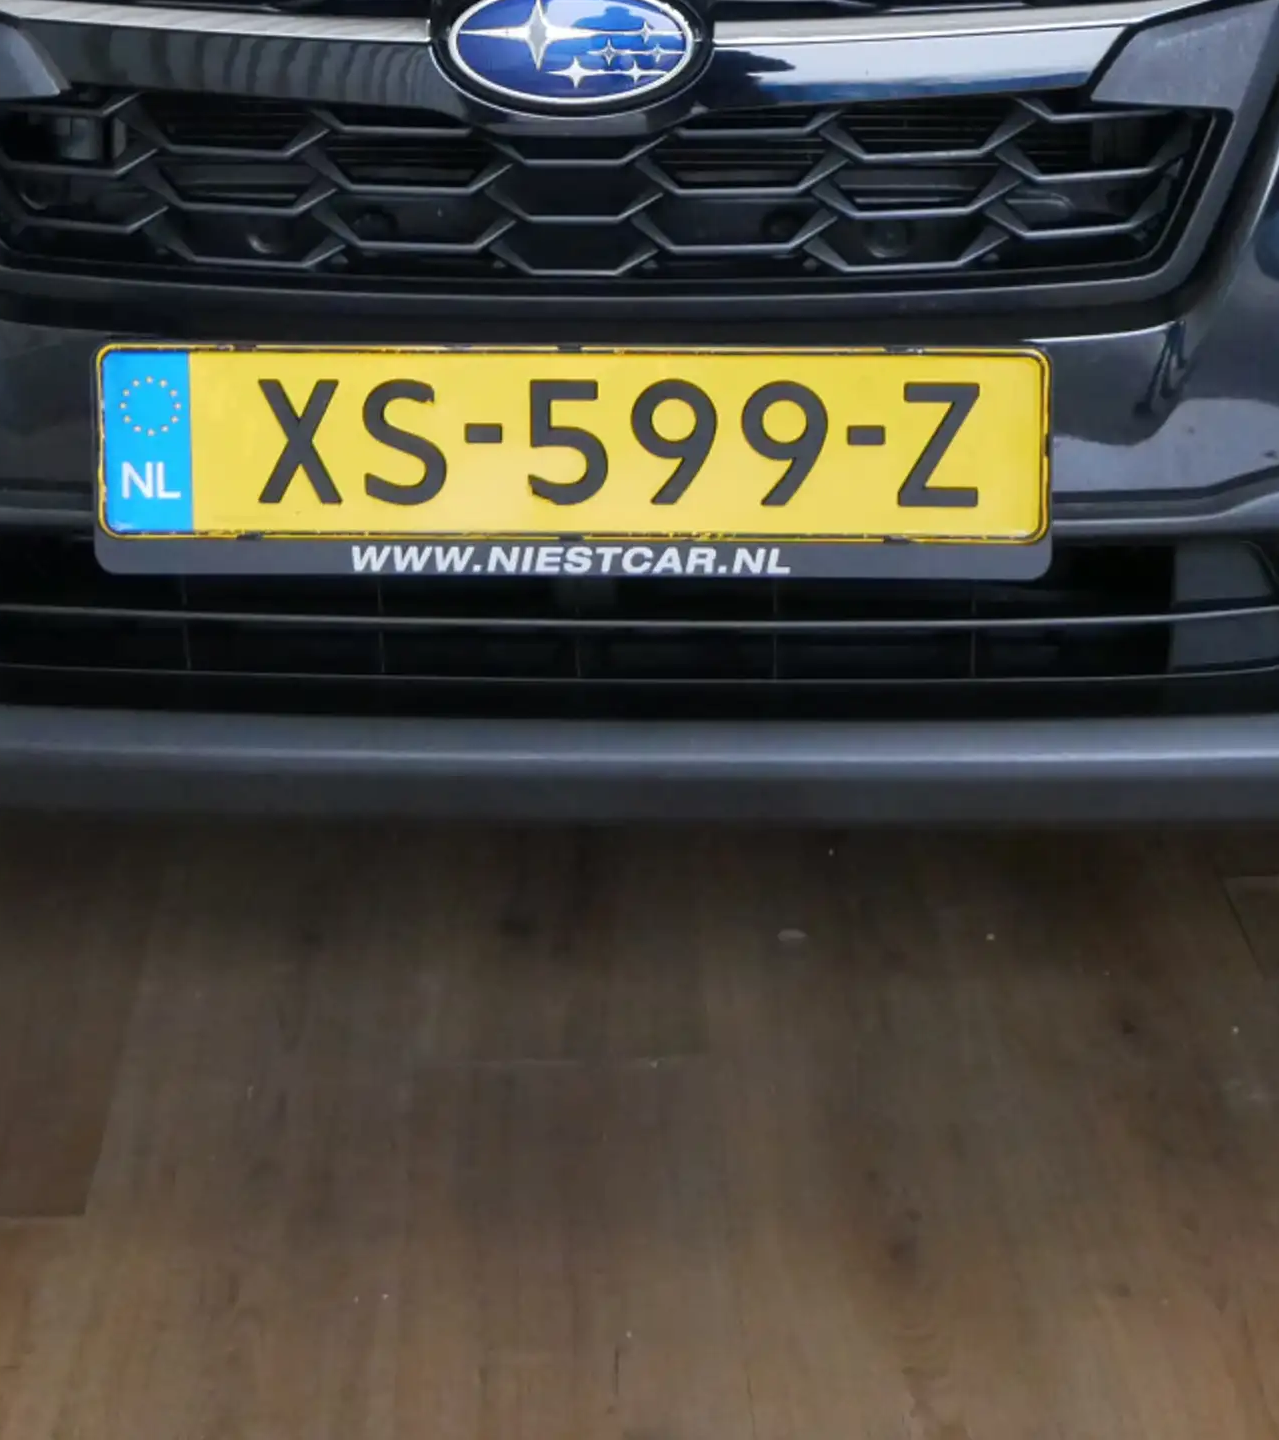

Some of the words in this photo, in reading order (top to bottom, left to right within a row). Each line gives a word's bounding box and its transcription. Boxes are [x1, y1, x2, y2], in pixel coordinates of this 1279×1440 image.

[257, 378, 981, 508] XS-599-Z
[121, 461, 182, 500] NL
[350, 544, 792, 576] WWW.NIESTCAR.NL
